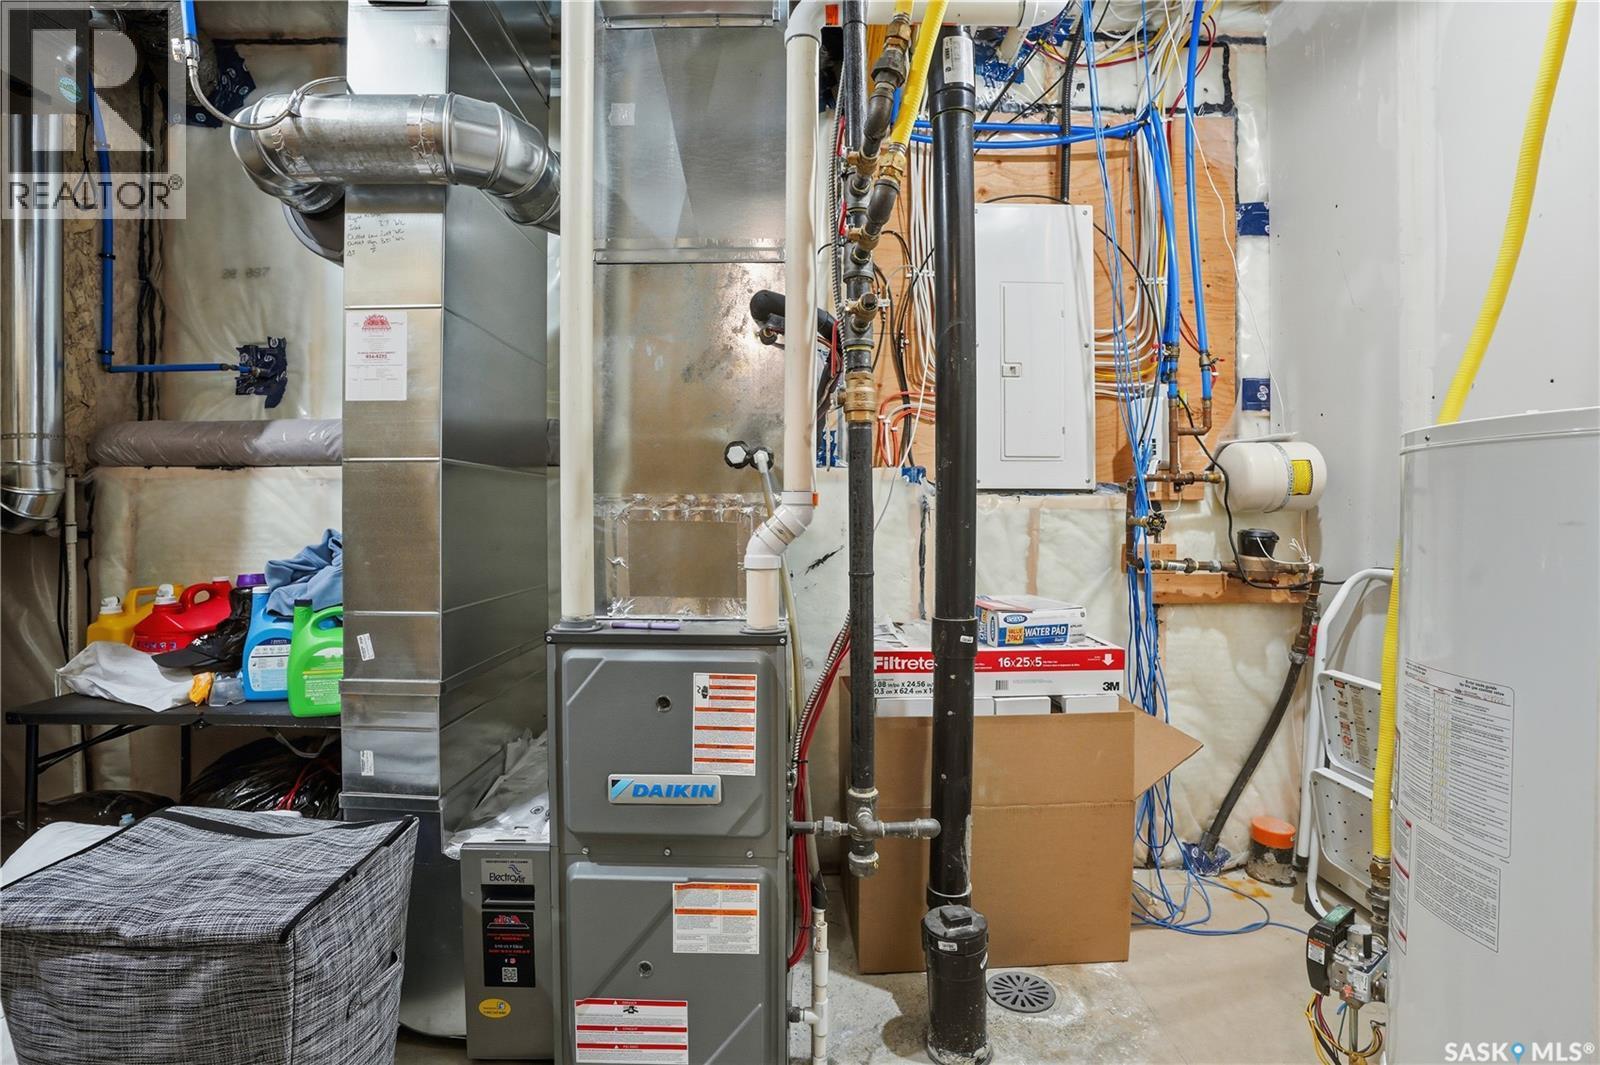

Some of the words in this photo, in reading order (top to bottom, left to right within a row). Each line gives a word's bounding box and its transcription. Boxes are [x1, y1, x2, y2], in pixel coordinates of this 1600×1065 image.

[1024, 627, 1050, 637] WATER
[1051, 625, 1067, 635] PAD
[873, 656, 935, 670] Filtrete
[997, 656, 1043, 668] 16x25x5
[1102, 681, 1120, 691] 3M
[632, 784, 716, 798] DAIKIN
